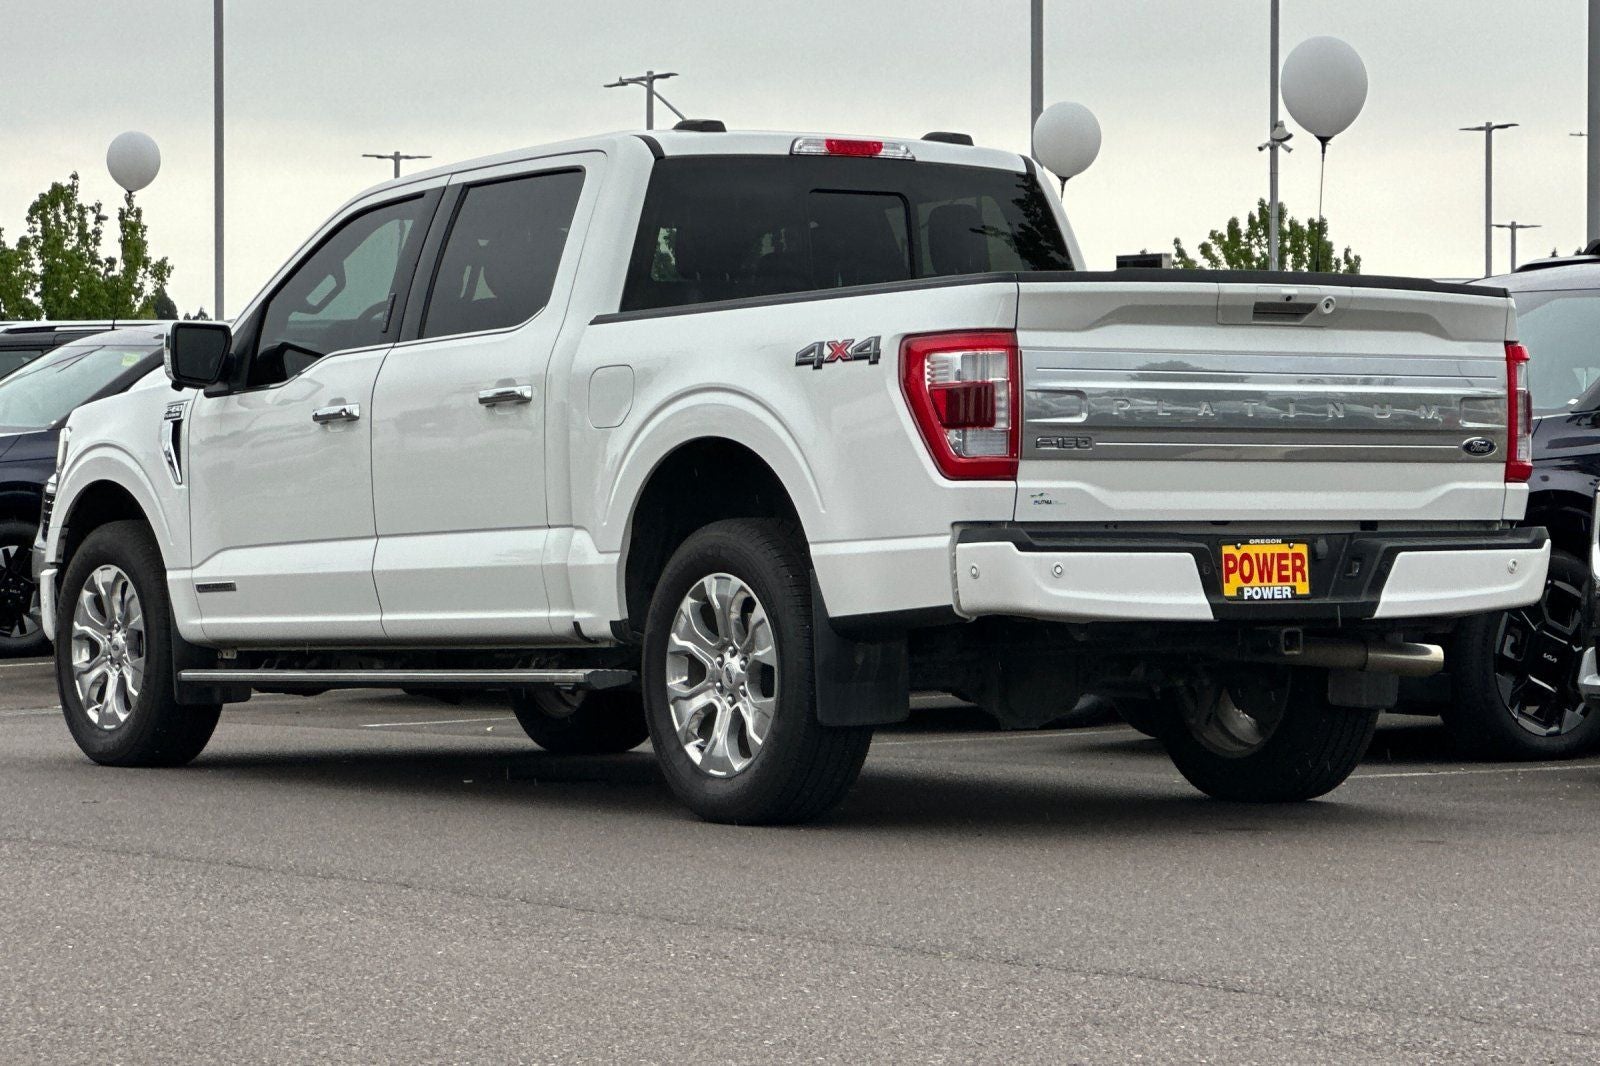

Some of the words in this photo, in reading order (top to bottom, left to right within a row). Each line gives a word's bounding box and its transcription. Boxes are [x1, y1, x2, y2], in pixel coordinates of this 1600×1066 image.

[1112, 399, 1441, 419] PLATINUM
[1223, 552, 1306, 584] POWER
[1243, 586, 1292, 600] POWER
